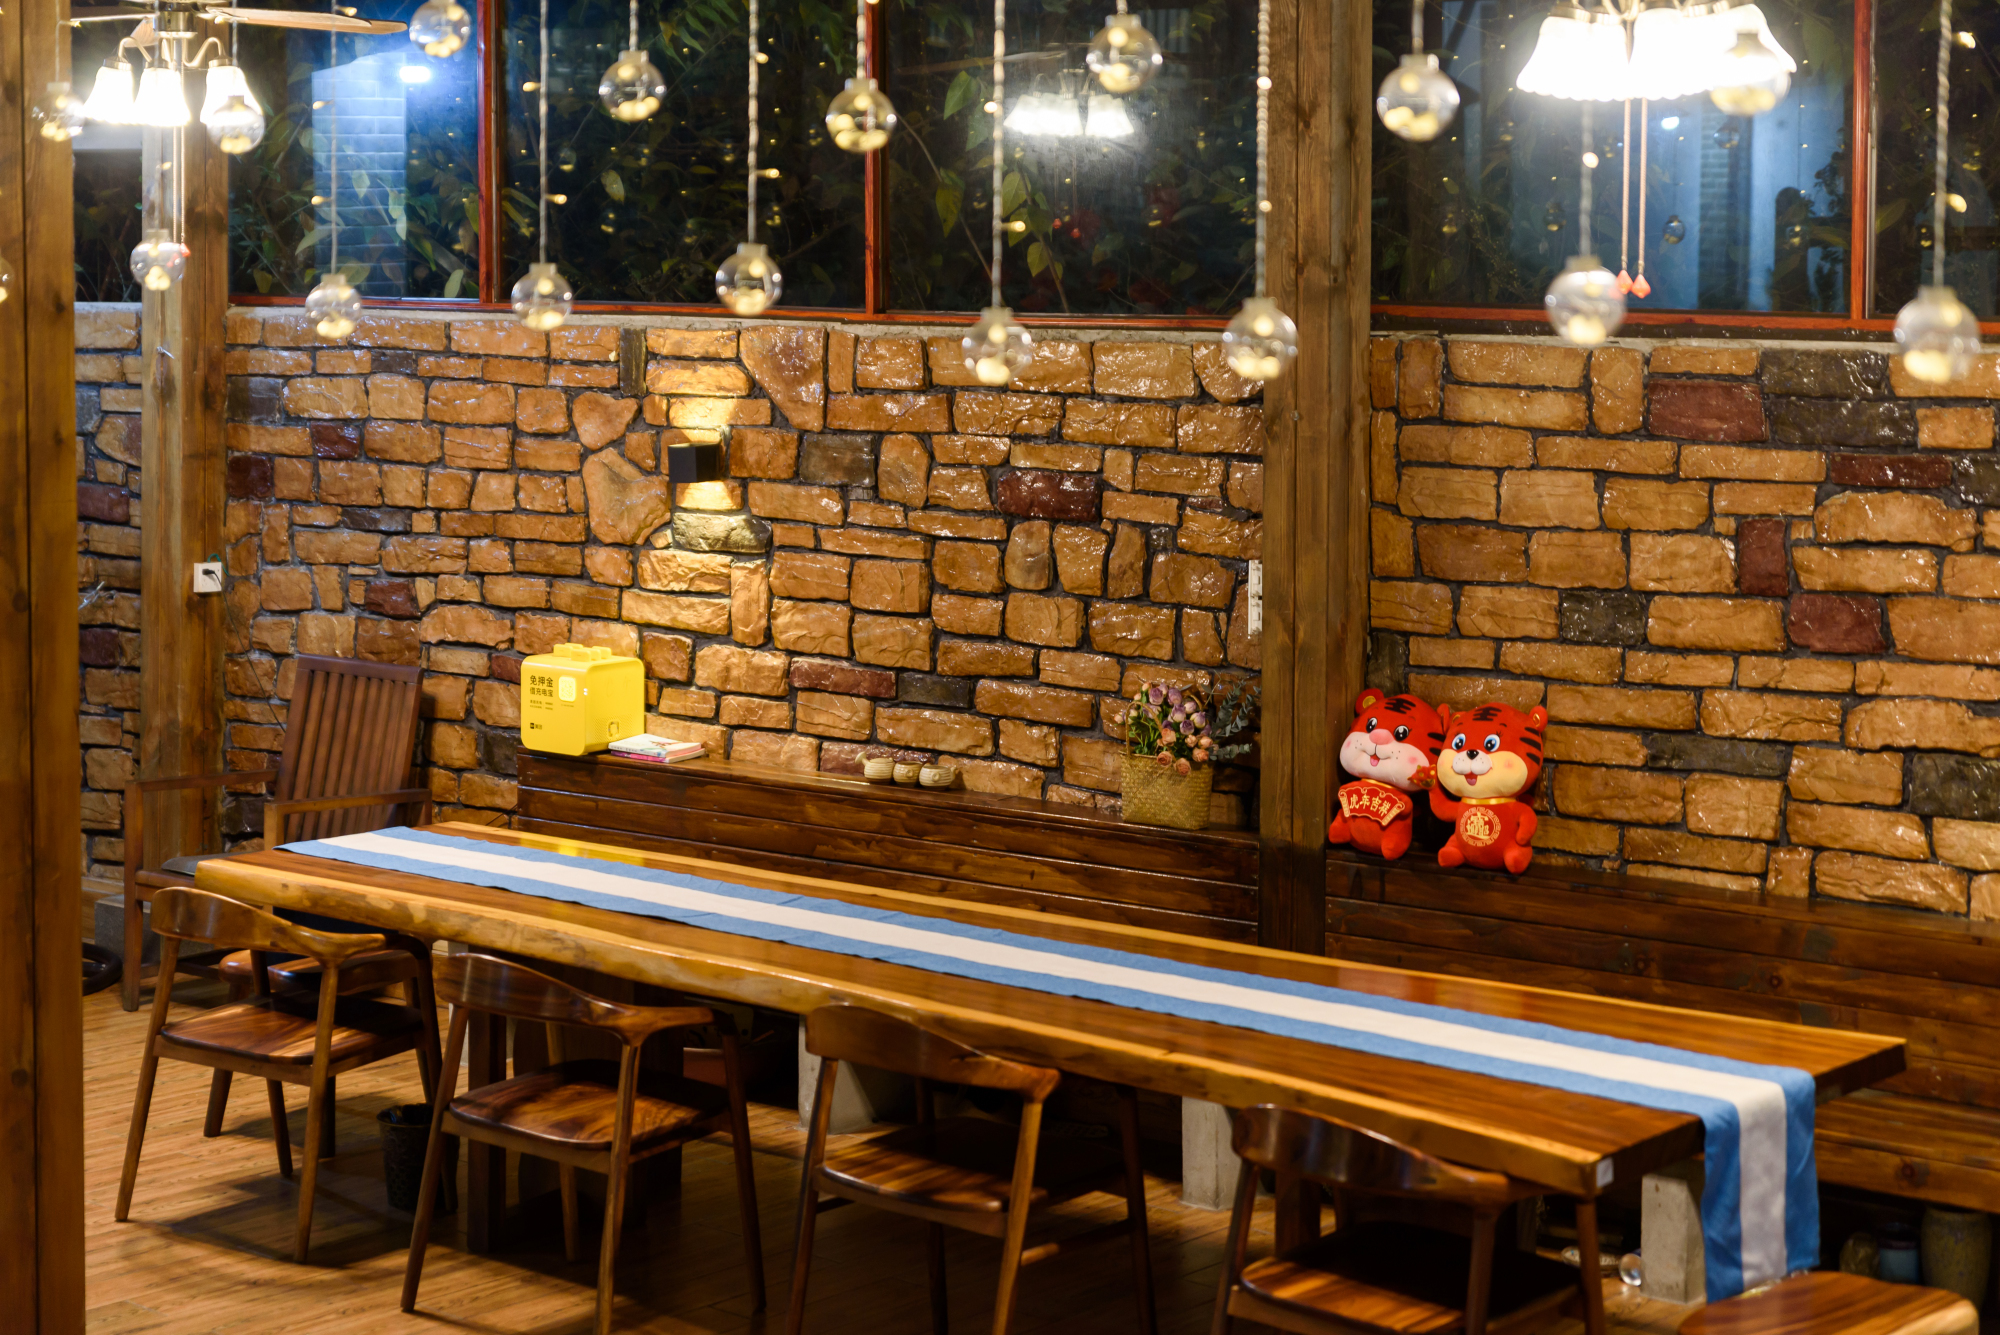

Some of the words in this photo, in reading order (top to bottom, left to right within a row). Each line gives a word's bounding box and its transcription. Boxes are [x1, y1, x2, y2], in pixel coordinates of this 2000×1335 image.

[530, 675, 553, 688] 免押金
[1349, 793, 1391, 817] 虎年吉祥
